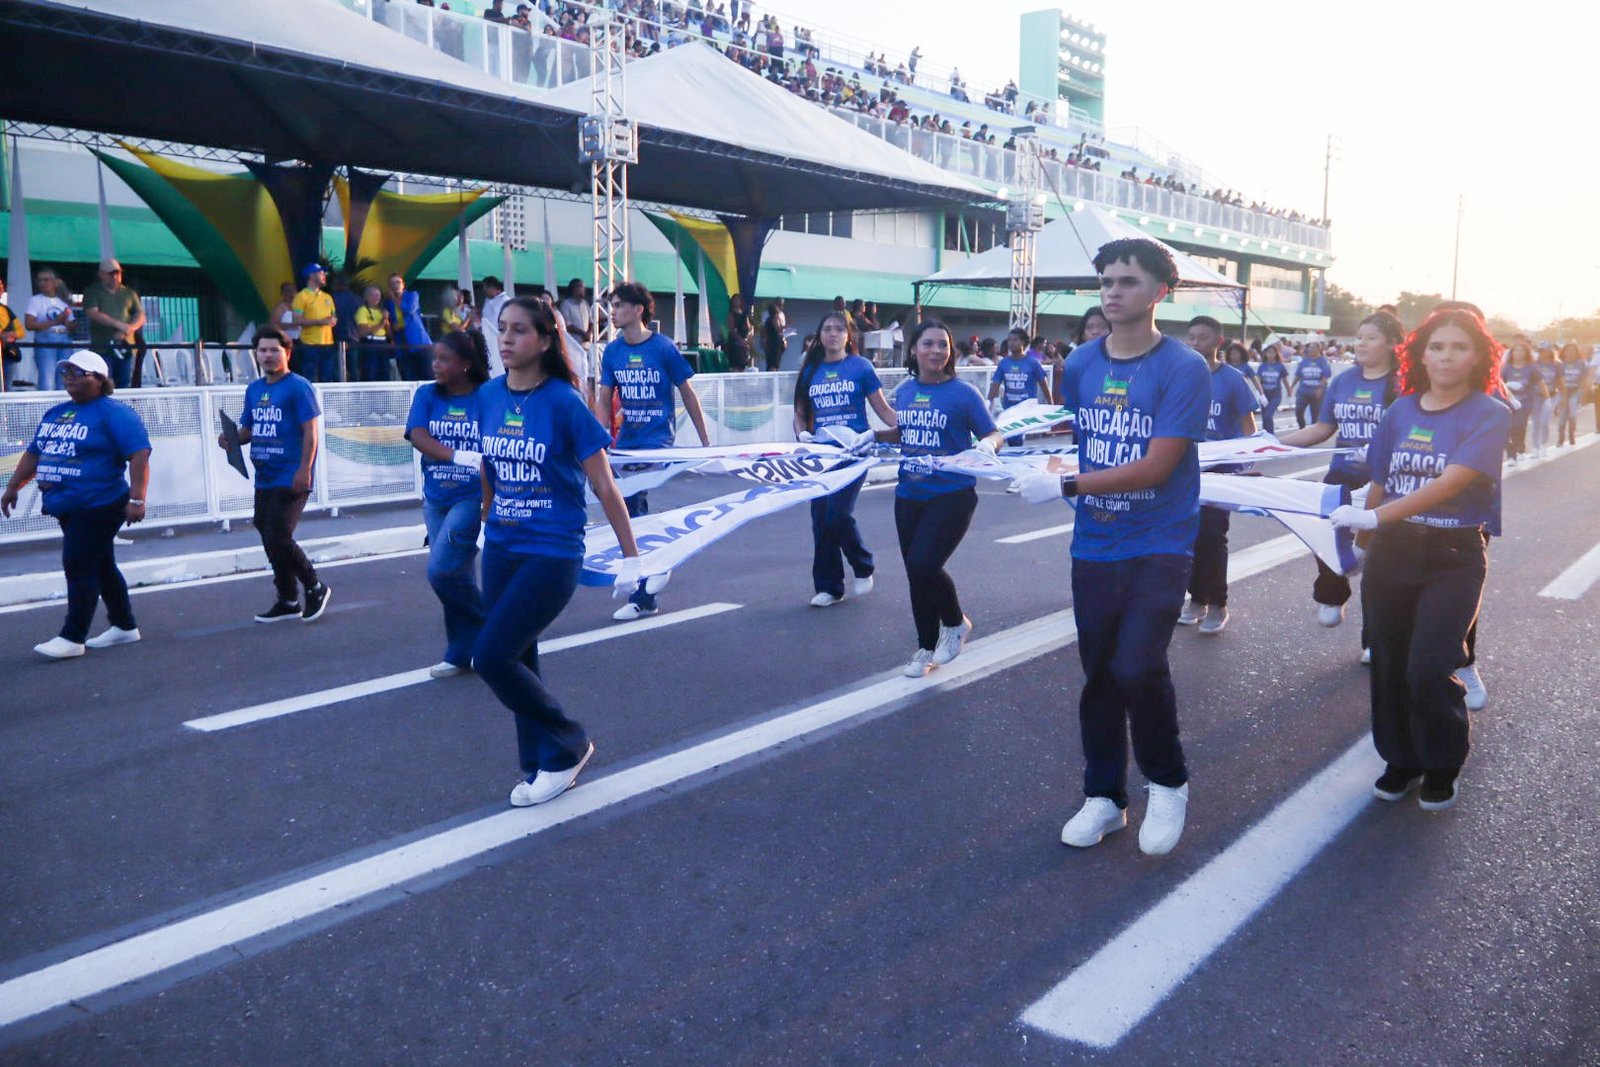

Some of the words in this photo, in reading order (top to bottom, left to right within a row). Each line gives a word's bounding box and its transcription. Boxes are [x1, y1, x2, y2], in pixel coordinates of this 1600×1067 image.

[614, 367, 660, 386] EDUCAÇÃO
[621, 383, 656, 400] PÚBLICA
[809, 379, 855, 397] EDUCAÇÃO
[813, 394, 850, 409] PÚBLICA
[1334, 403, 1388, 423] DUCAÇÃ
[37, 422, 88, 440] DUCAÇÃO
[429, 420, 481, 441] DUCAÇÃ
[497, 427, 525, 437] AMAPÁ
[526, 500, 552, 509] PONTES
[1105, 499, 1130, 511] CÍVICO
